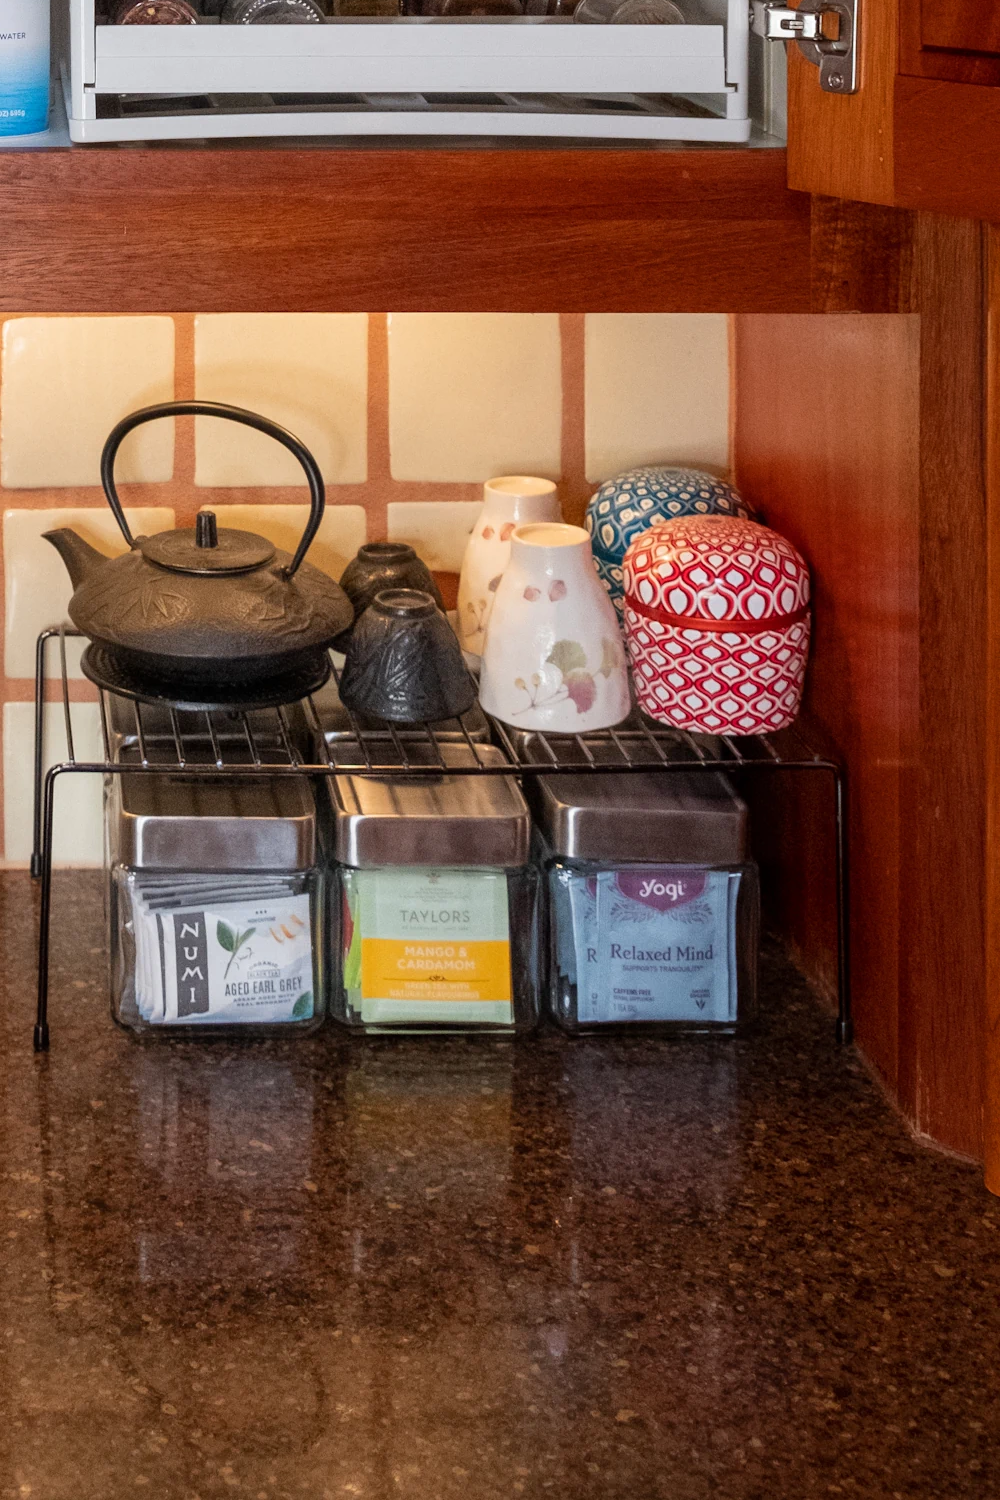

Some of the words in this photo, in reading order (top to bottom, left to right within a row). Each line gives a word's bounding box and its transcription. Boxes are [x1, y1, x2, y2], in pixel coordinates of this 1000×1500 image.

[0, 32, 26, 40] WATER
[400, 910, 470, 923] TAYLORS
[404, 946, 454, 957] MANGO
[459, 947, 467, 957] &
[610, 943, 671, 961] Relaxed
[676, 944, 713, 960] Mind
[180, 922, 204, 1003] NUMI
[397, 958, 476, 970] CARDAMOM
[225, 982, 249, 996] AGED
[253, 979, 276, 994] EARL
[280, 976, 302, 992] GREY
